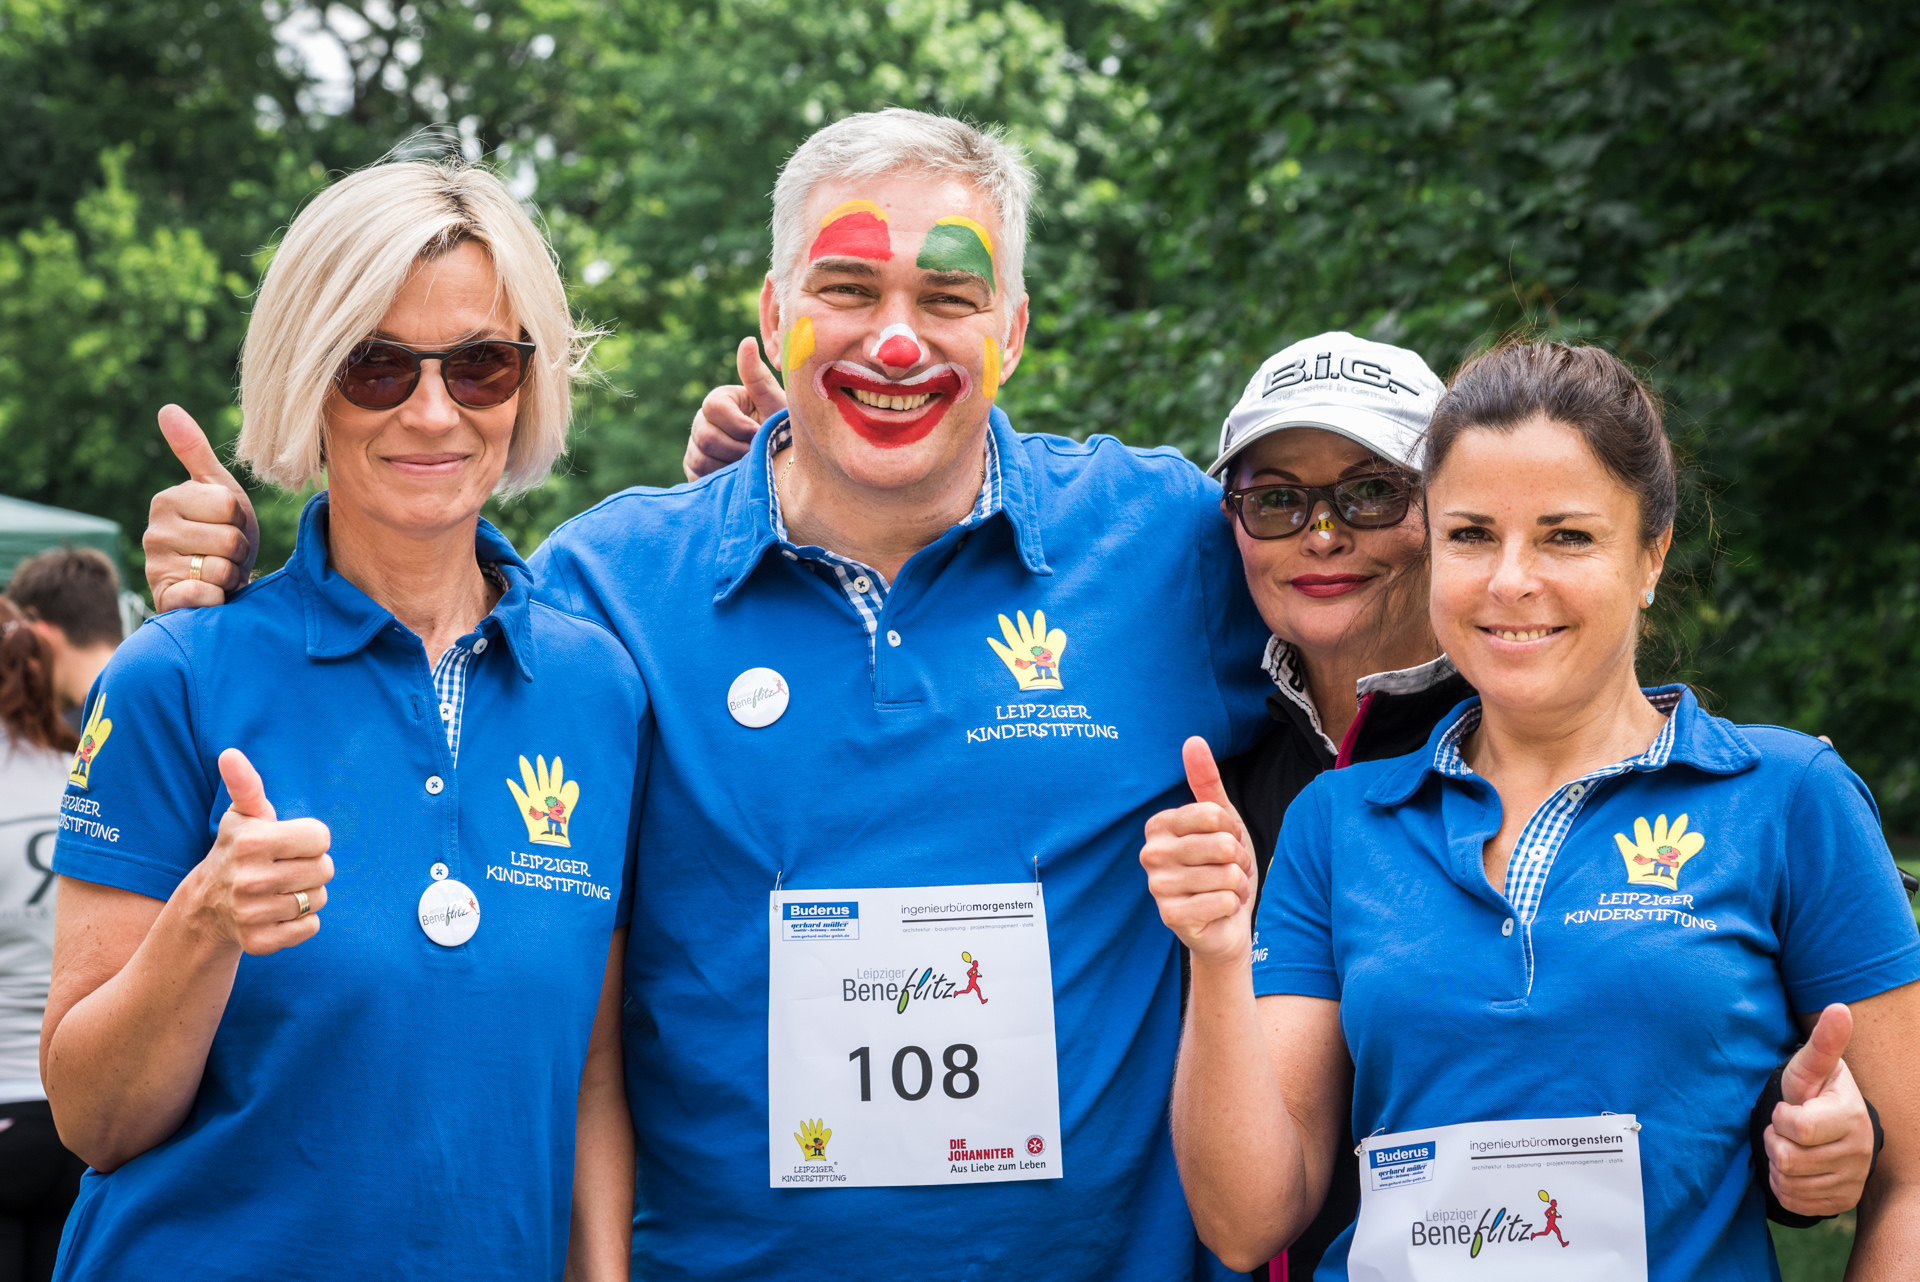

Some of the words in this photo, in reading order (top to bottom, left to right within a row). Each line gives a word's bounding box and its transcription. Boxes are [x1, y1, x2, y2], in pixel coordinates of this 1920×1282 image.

[996, 703, 1091, 720] LEIPZIGER
[966, 723, 1119, 744] KINDERSTIFTUNG
[511, 851, 591, 877] LEIPZIGER
[486, 864, 611, 900] KINDERSTIFTUNG
[901, 900, 1034, 916] ingenieurbüromorgenstern
[1598, 892, 1694, 910] LEIPZIGER
[790, 904, 850, 916] Buderus
[790, 921, 822, 930] gerhard
[1564, 908, 1718, 931] KINDERSTIFTUNG
[856, 967, 906, 982] Leipziger
[849, 1043, 980, 1102] 108
[949, 1138, 967, 1150] DIE
[1469, 1134, 1623, 1152] ingenieurbüromorgenstern
[948, 1147, 1014, 1161] JOHANNITER
[1376, 1147, 1429, 1163] Buderus
[793, 1165, 835, 1173] LEIPZIGER
[950, 1164, 968, 1174] Aus
[971, 1162, 995, 1172] Liebe
[997, 1163, 1016, 1171] zum
[1019, 1160, 1046, 1170] Leben
[1546, 1159, 1604, 1167] projektmanagement
[782, 1174, 847, 1182] KINDERSTIFTUNG
[1425, 1209, 1478, 1223] Leipziger
